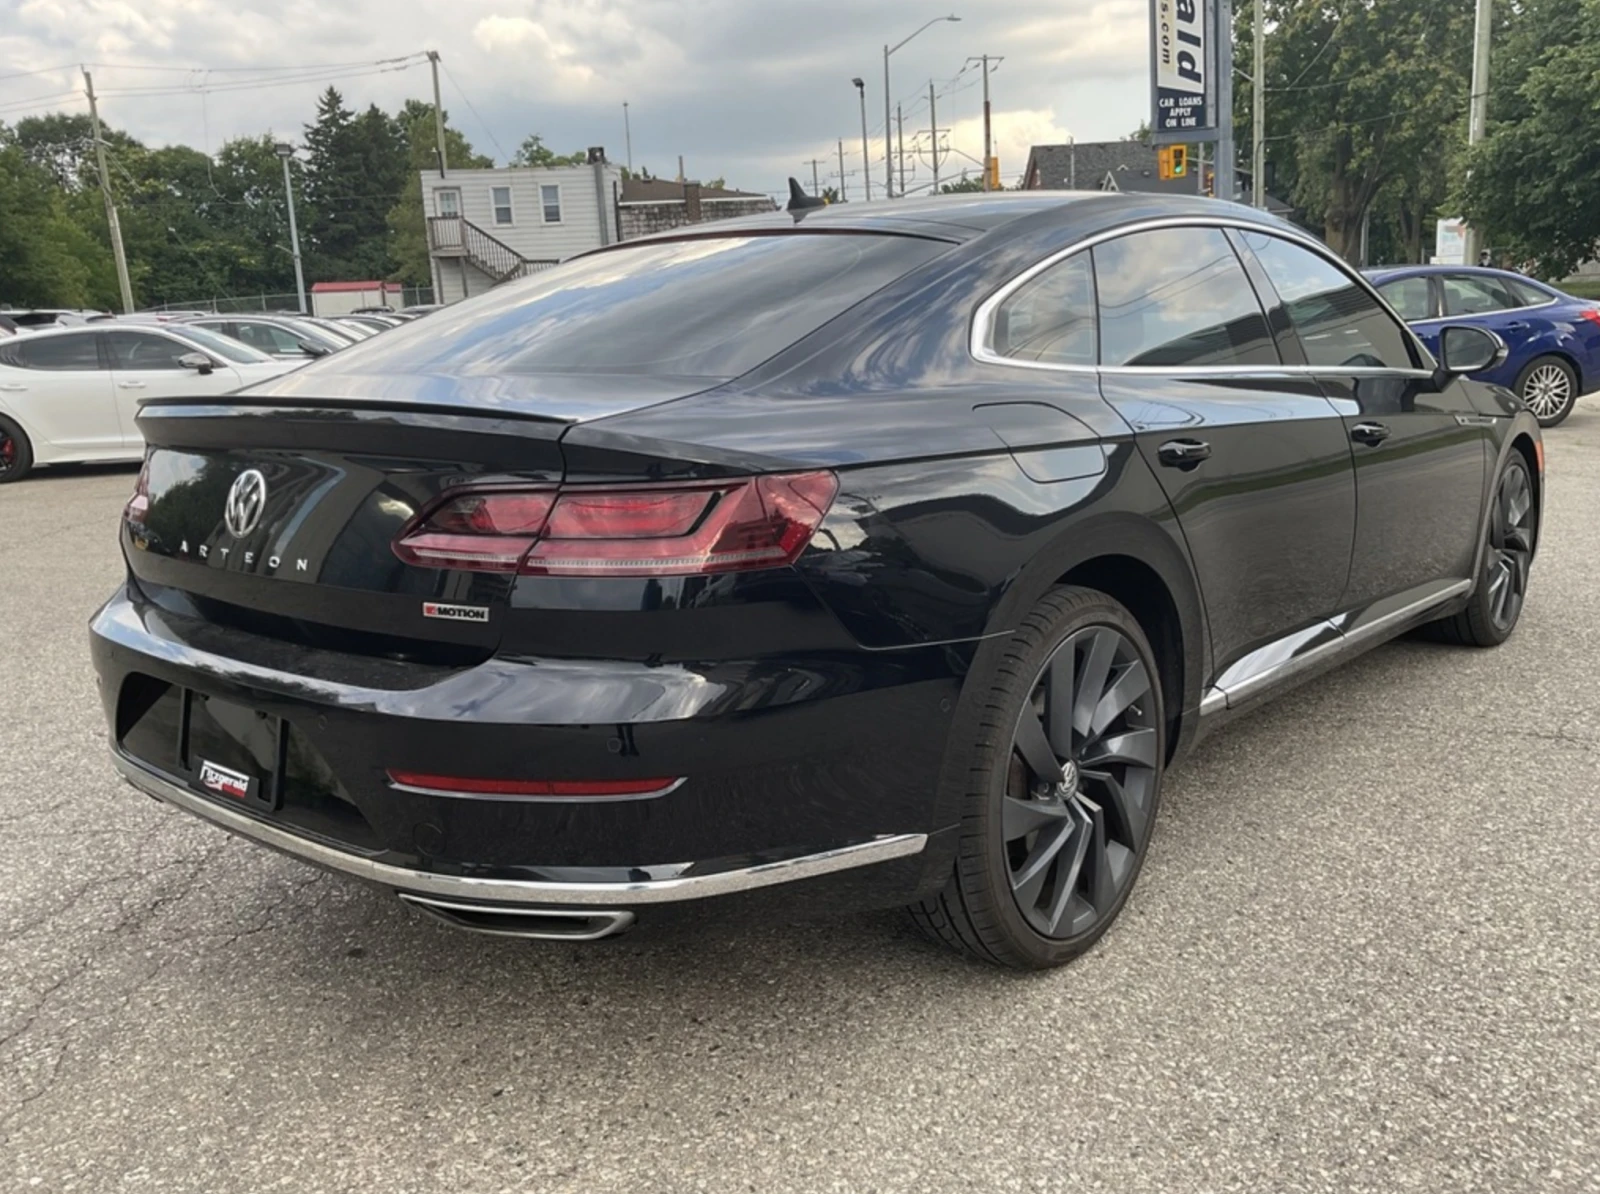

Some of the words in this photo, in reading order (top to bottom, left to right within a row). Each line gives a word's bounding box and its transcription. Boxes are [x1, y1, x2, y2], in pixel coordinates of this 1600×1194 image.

[1160, 0, 1170, 64] s.com
[1159, 98, 1175, 107] CAR
[1178, 96, 1202, 106] LOANS
[1169, 107, 1191, 117] APPLY
[1165, 118, 1177, 127] ON
[1181, 117, 1197, 127] LINE
[180, 540, 308, 571] ARTEON
